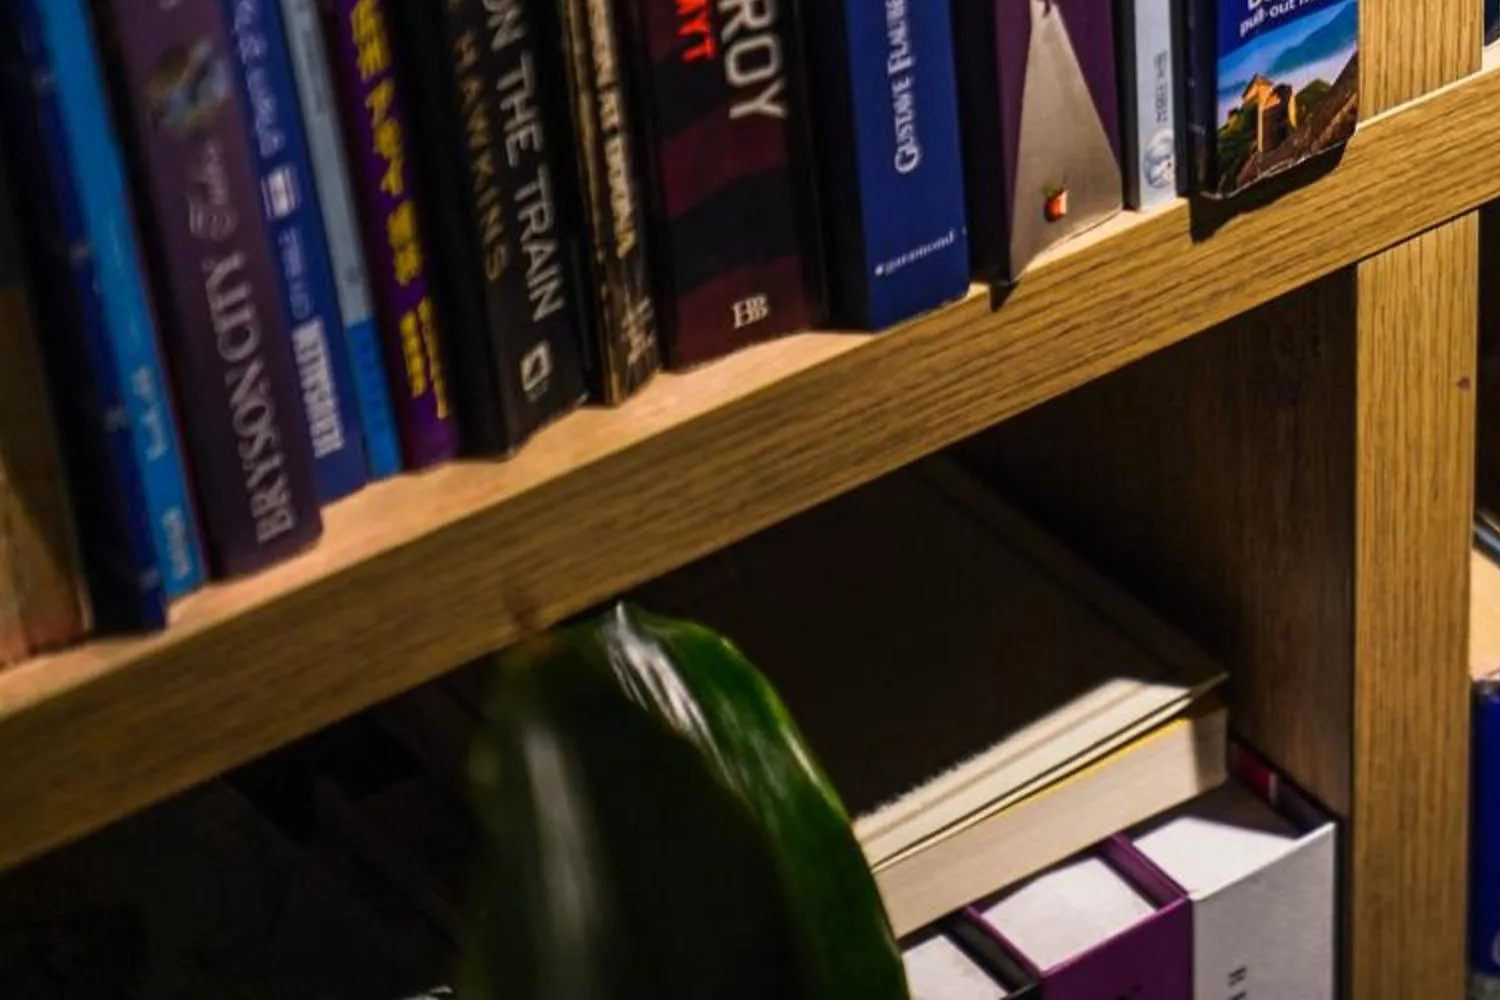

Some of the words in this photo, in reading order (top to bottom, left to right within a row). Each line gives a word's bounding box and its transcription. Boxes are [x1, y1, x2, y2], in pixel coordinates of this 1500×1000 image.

[496, 52, 547, 168] THE
[202, 246, 262, 364] CITY
[514, 166, 567, 324] TRAIN
[222, 357, 296, 546] BRYSON
